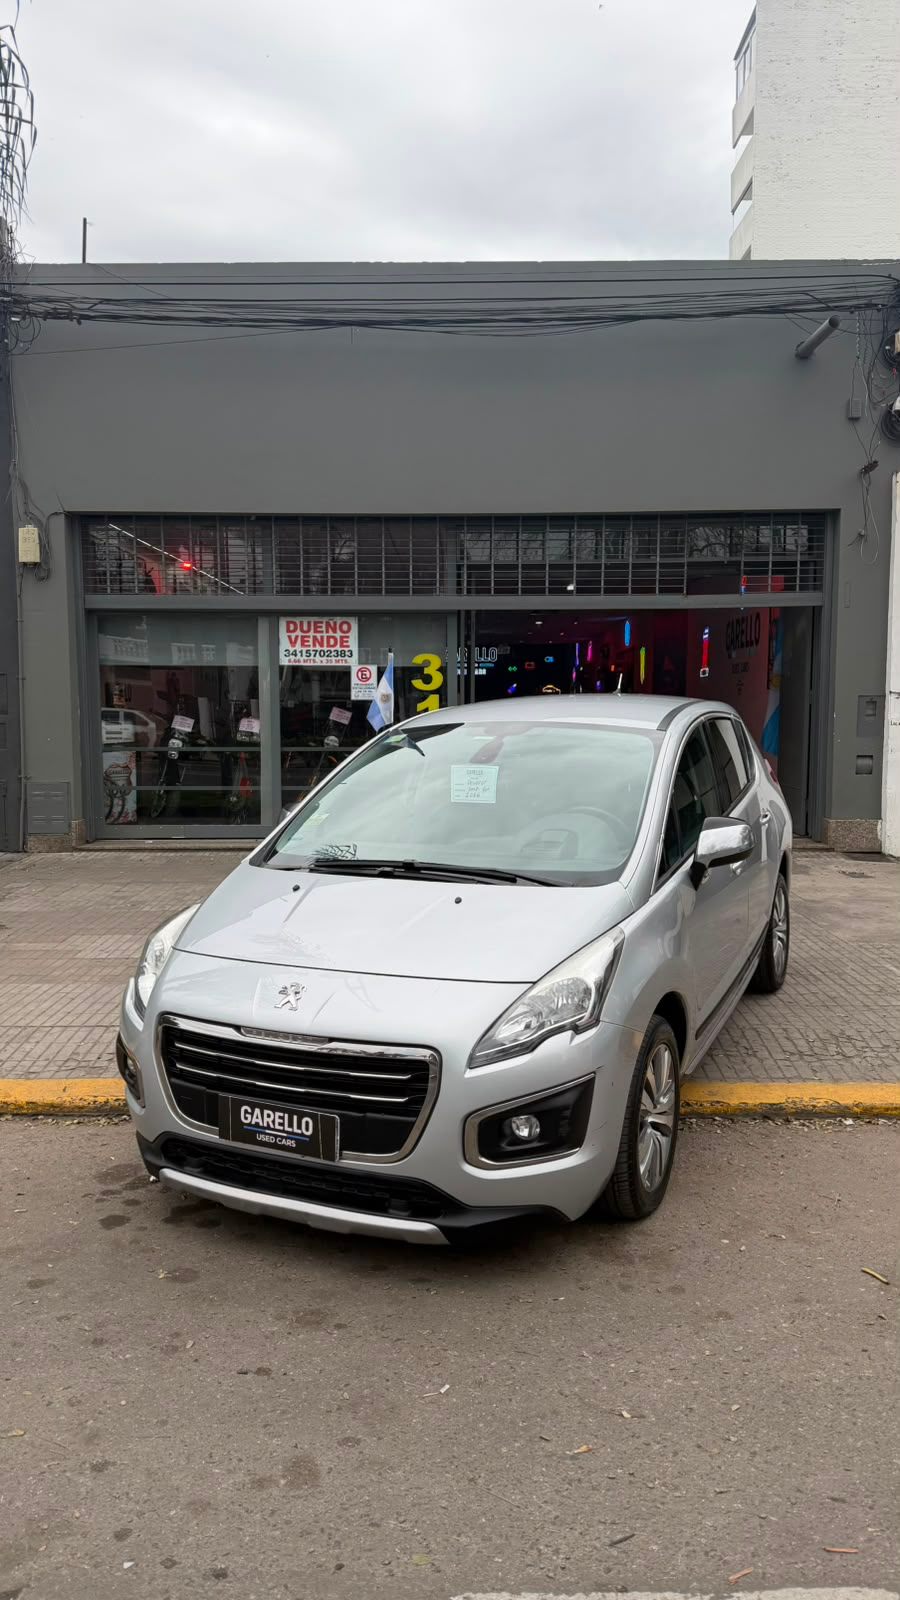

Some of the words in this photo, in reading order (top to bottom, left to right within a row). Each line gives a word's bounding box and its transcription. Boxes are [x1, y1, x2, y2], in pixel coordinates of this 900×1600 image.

[286, 618, 352, 634] DUEÑO
[287, 635, 351, 648] VENDE
[284, 649, 353, 658] 3415702383
[240, 1105, 313, 1136] GARELLO
[256, 1133, 276, 1144] USED
[276, 1137, 296, 1148] CARS
